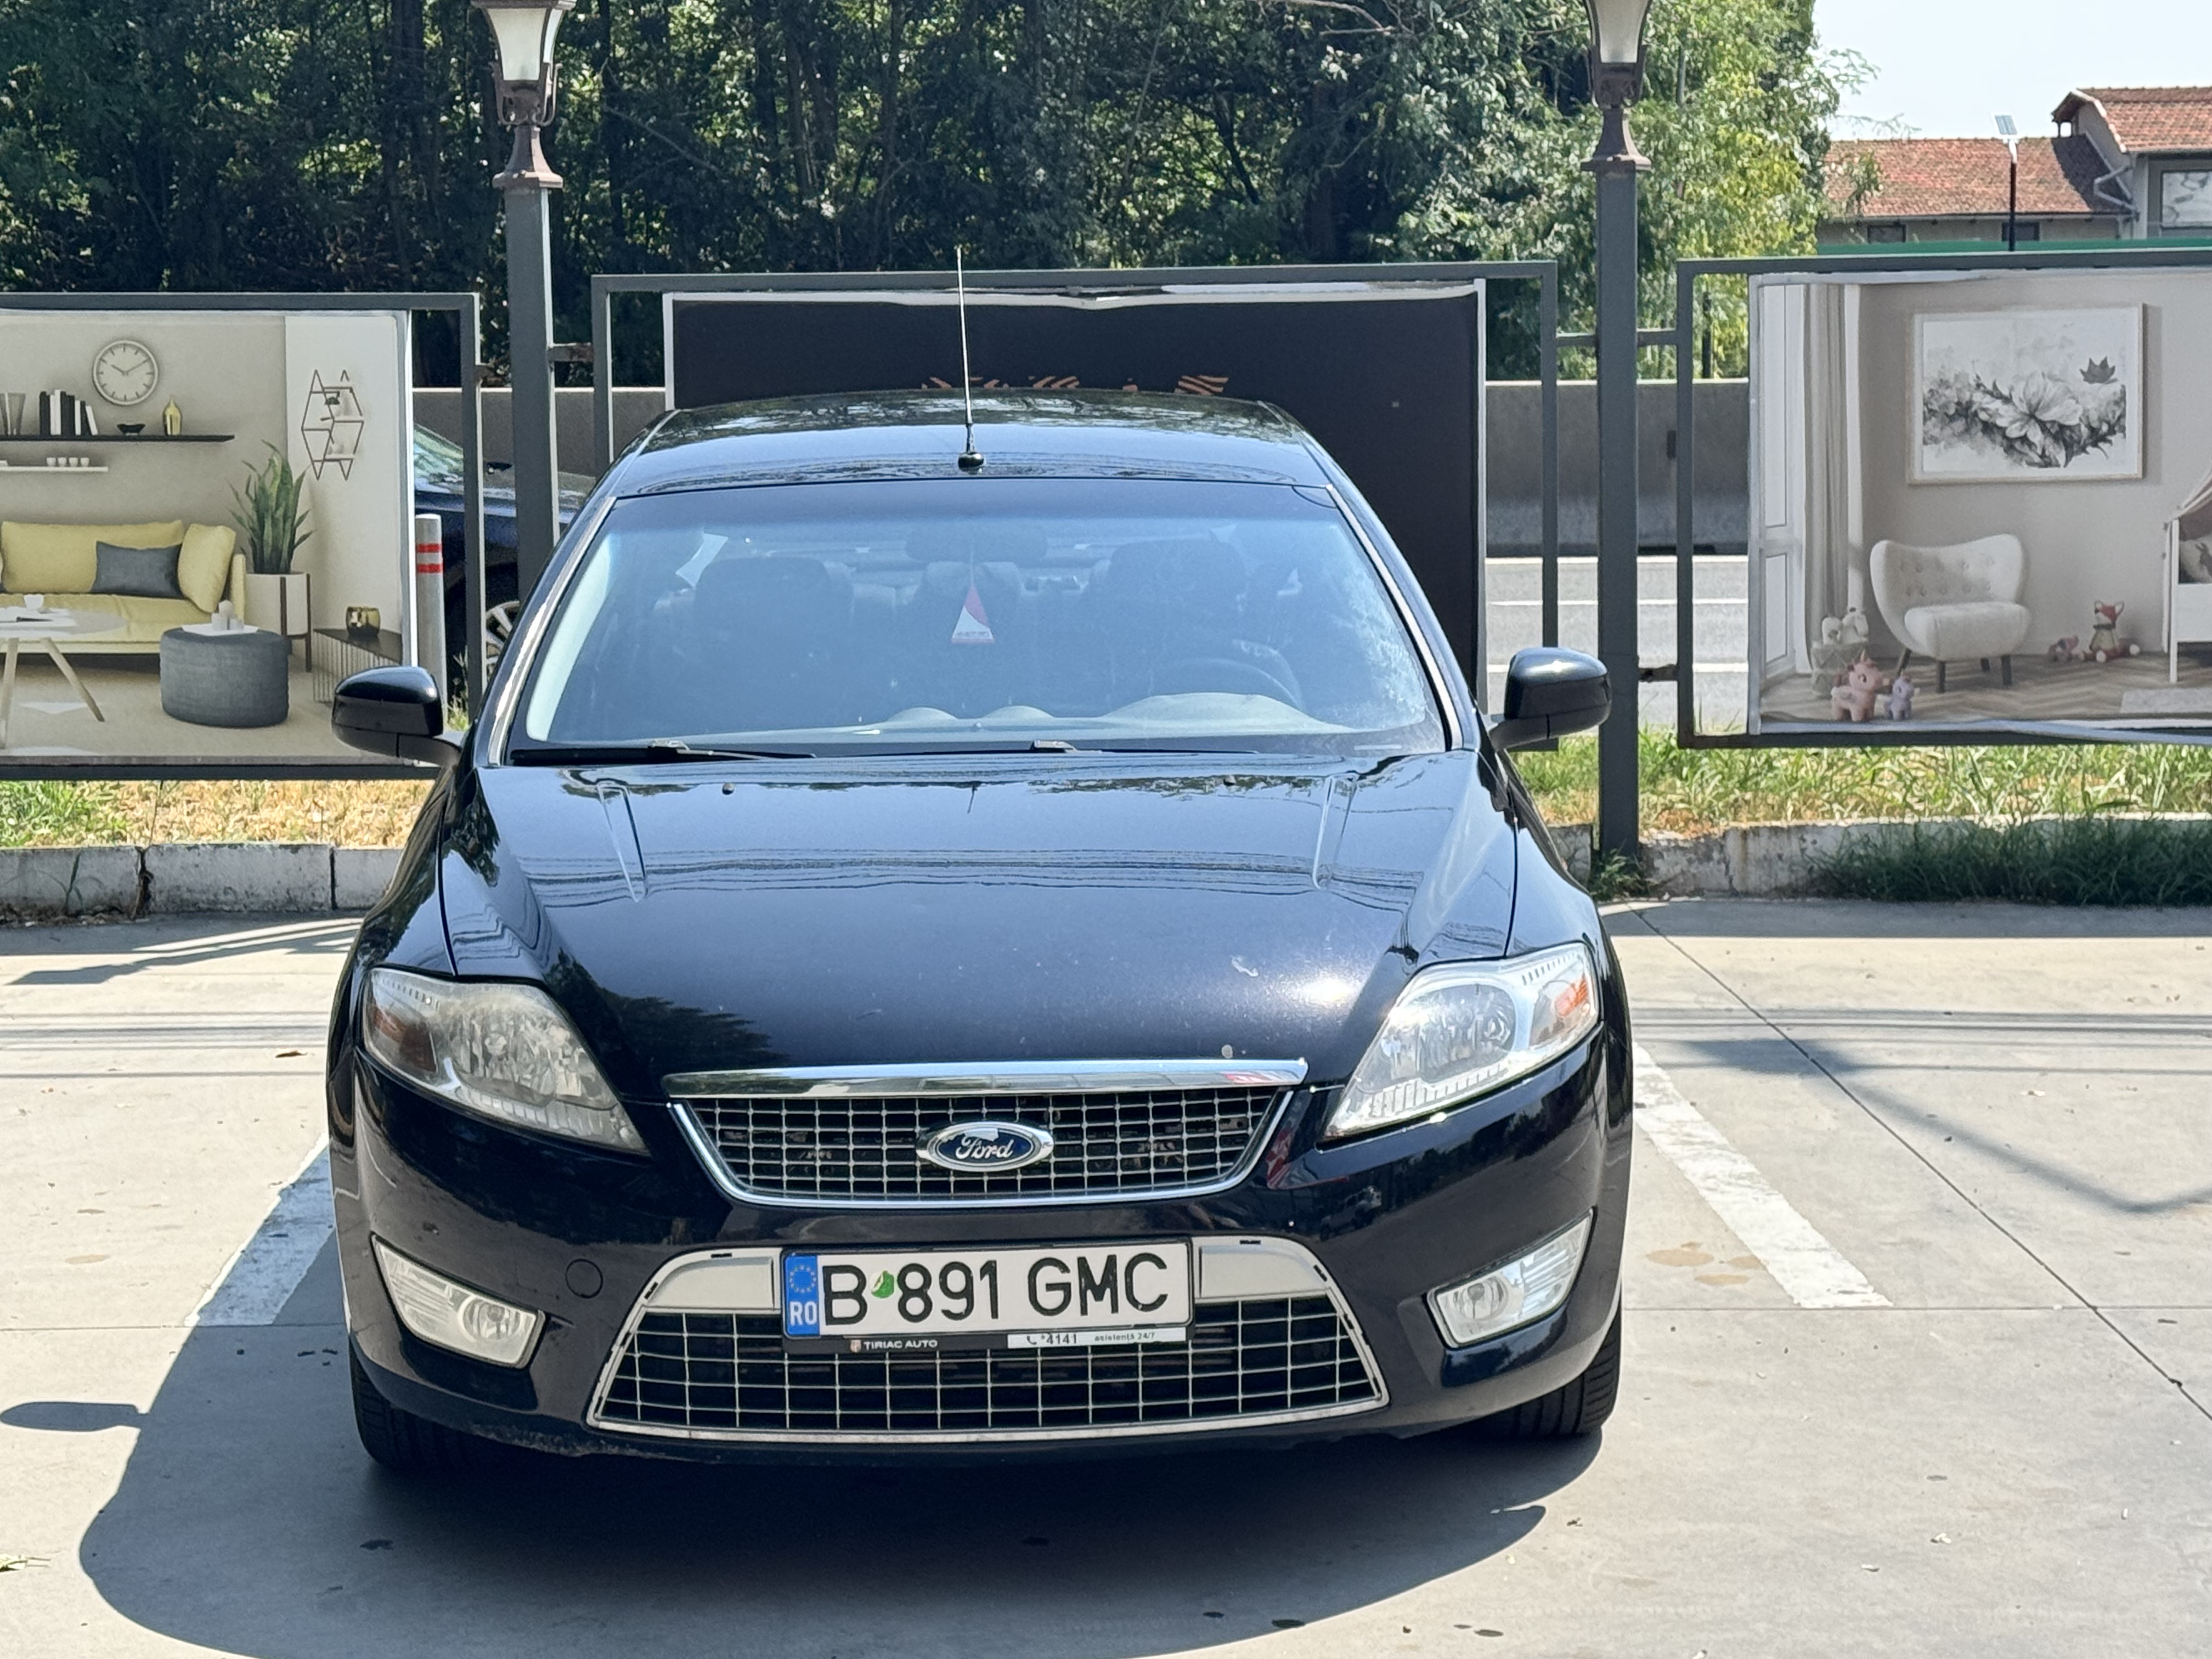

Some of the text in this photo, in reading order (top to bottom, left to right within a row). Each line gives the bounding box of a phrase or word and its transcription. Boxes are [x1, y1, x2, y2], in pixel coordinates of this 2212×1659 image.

[956, 1134, 1014, 1159] Ford
[822, 1252, 1168, 1326] B 891 GMC
[789, 1301, 817, 1326] RO
[905, 1340, 938, 1348] AUTO
